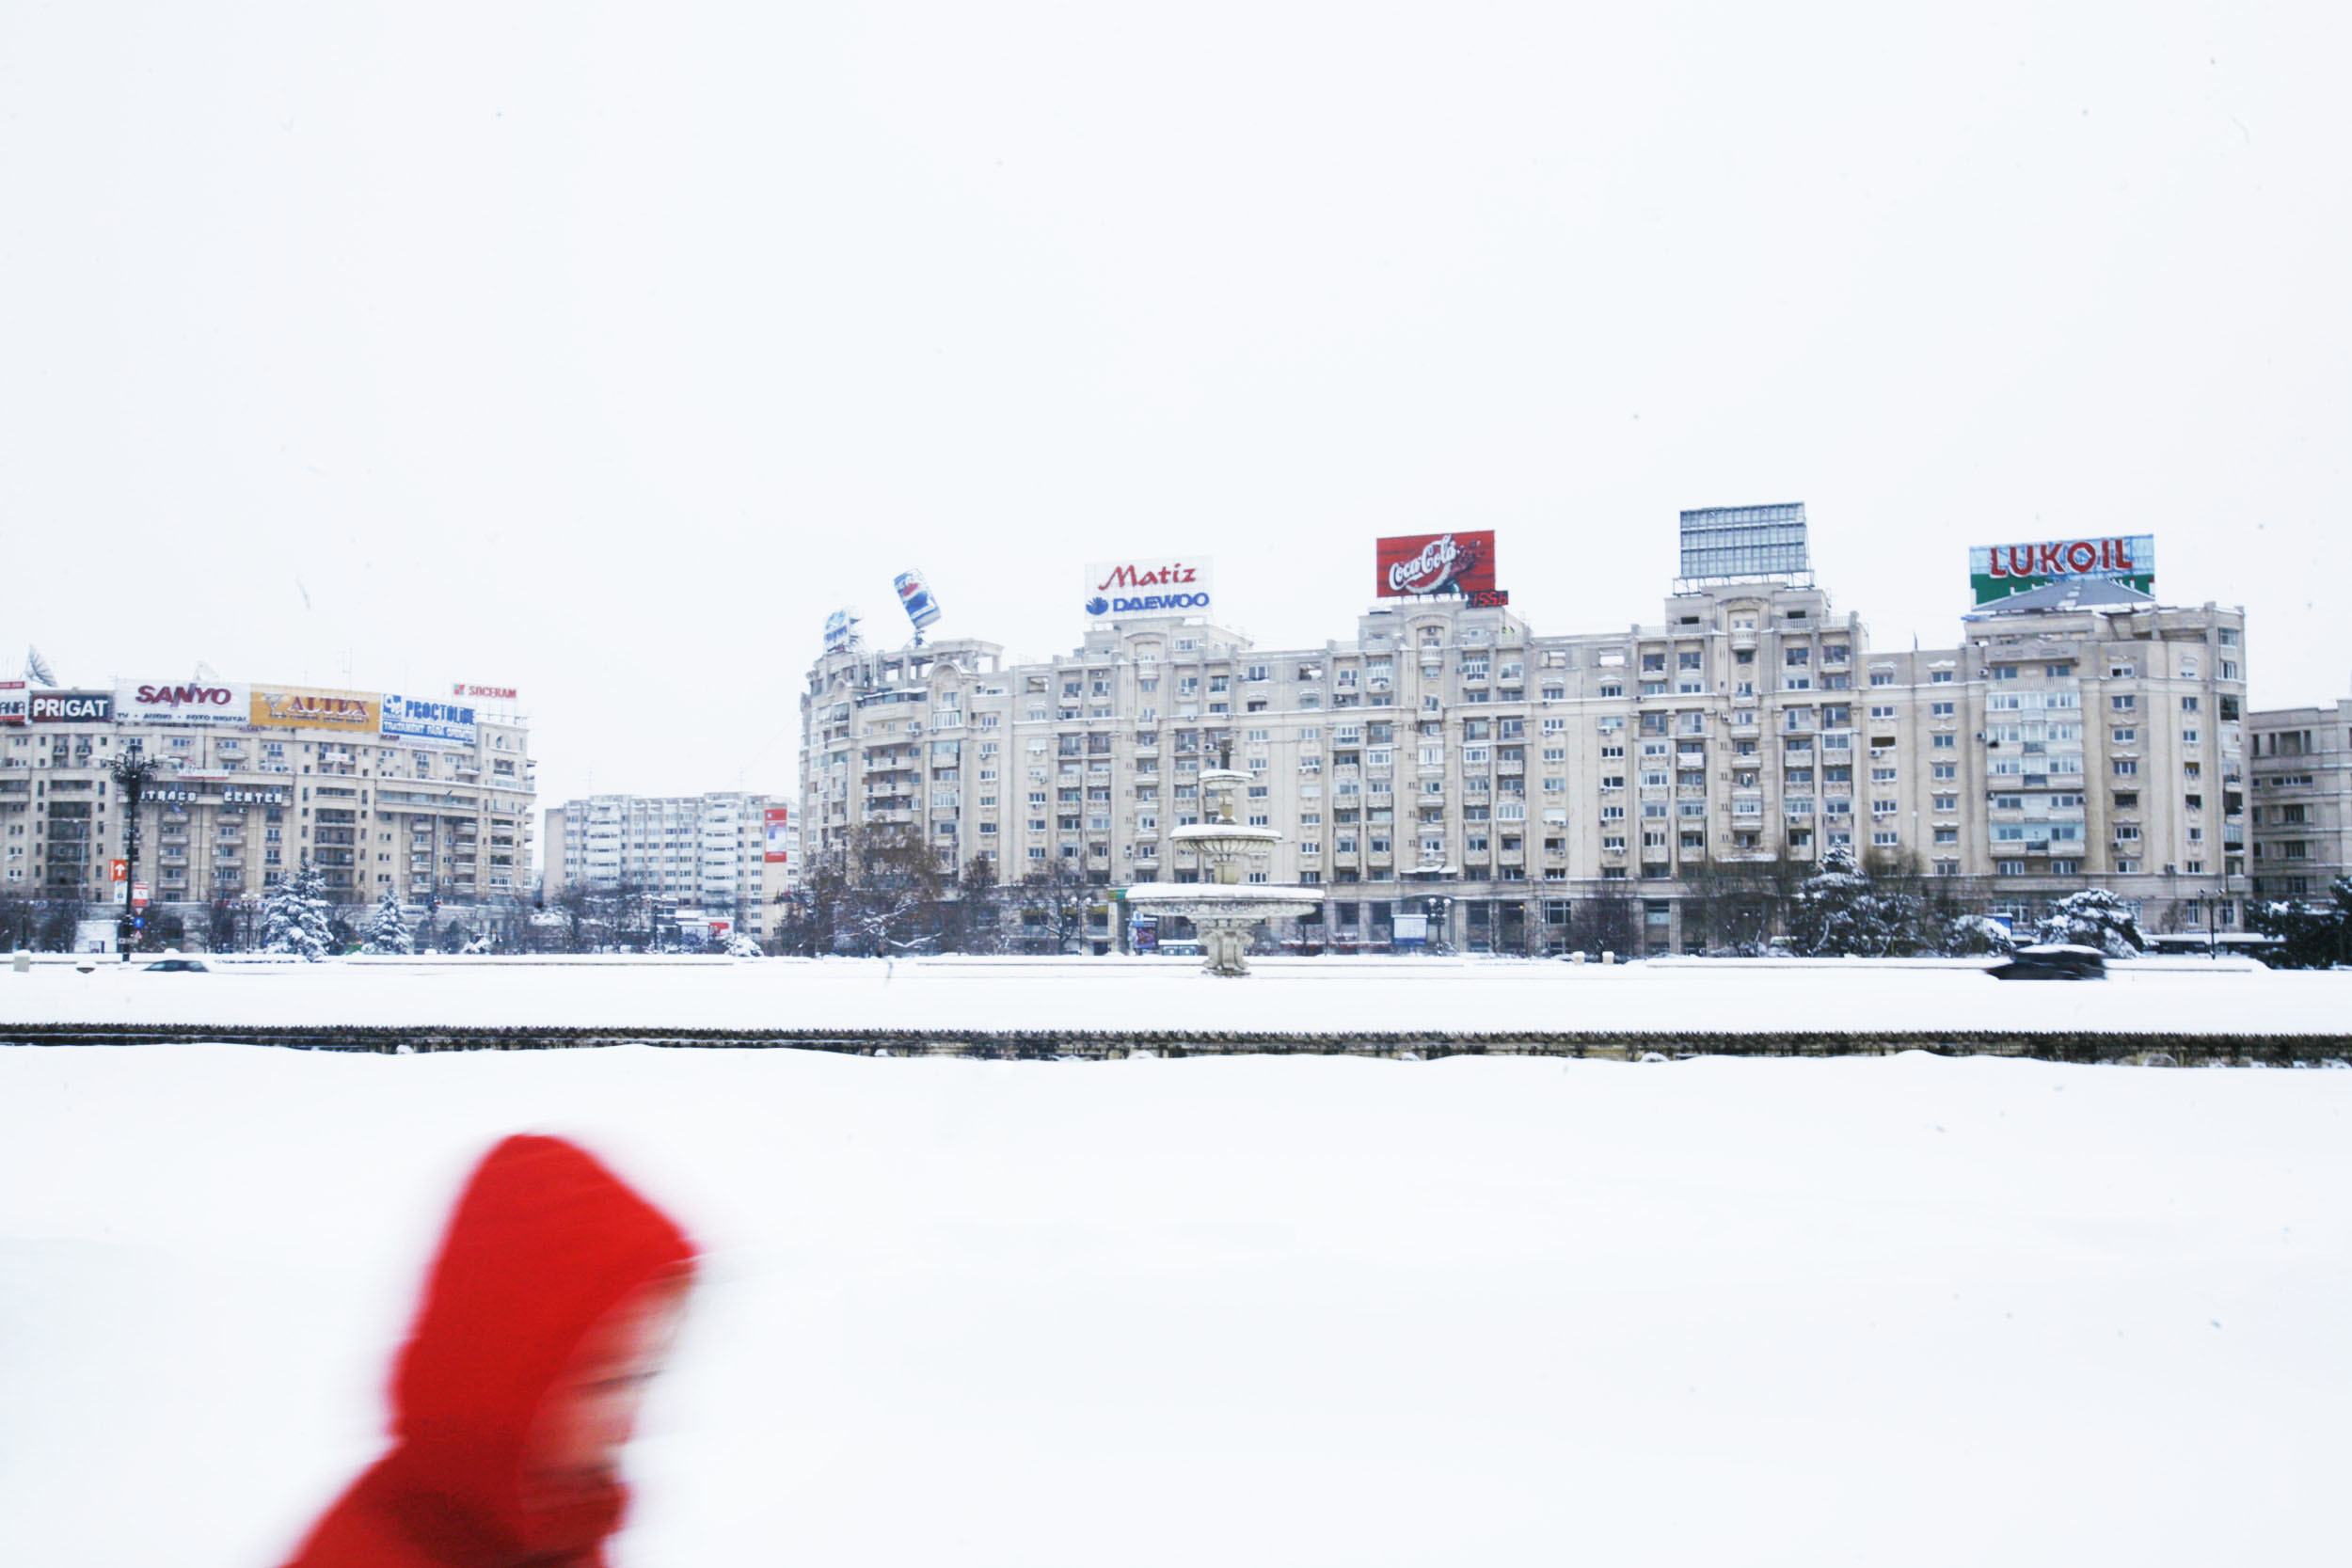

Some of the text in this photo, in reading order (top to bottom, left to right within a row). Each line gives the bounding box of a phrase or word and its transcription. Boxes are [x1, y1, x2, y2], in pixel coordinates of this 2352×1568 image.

[1990, 539, 2134, 578] LUKOIL
[1098, 562, 1196, 591] Matiz
[1113, 593, 1210, 611] DAEWOO
[135, 683, 231, 707] SANYO
[287, 695, 369, 716] ALTEX
[33, 698, 108, 717] PRIGAT
[224, 791, 282, 804] CENTER
